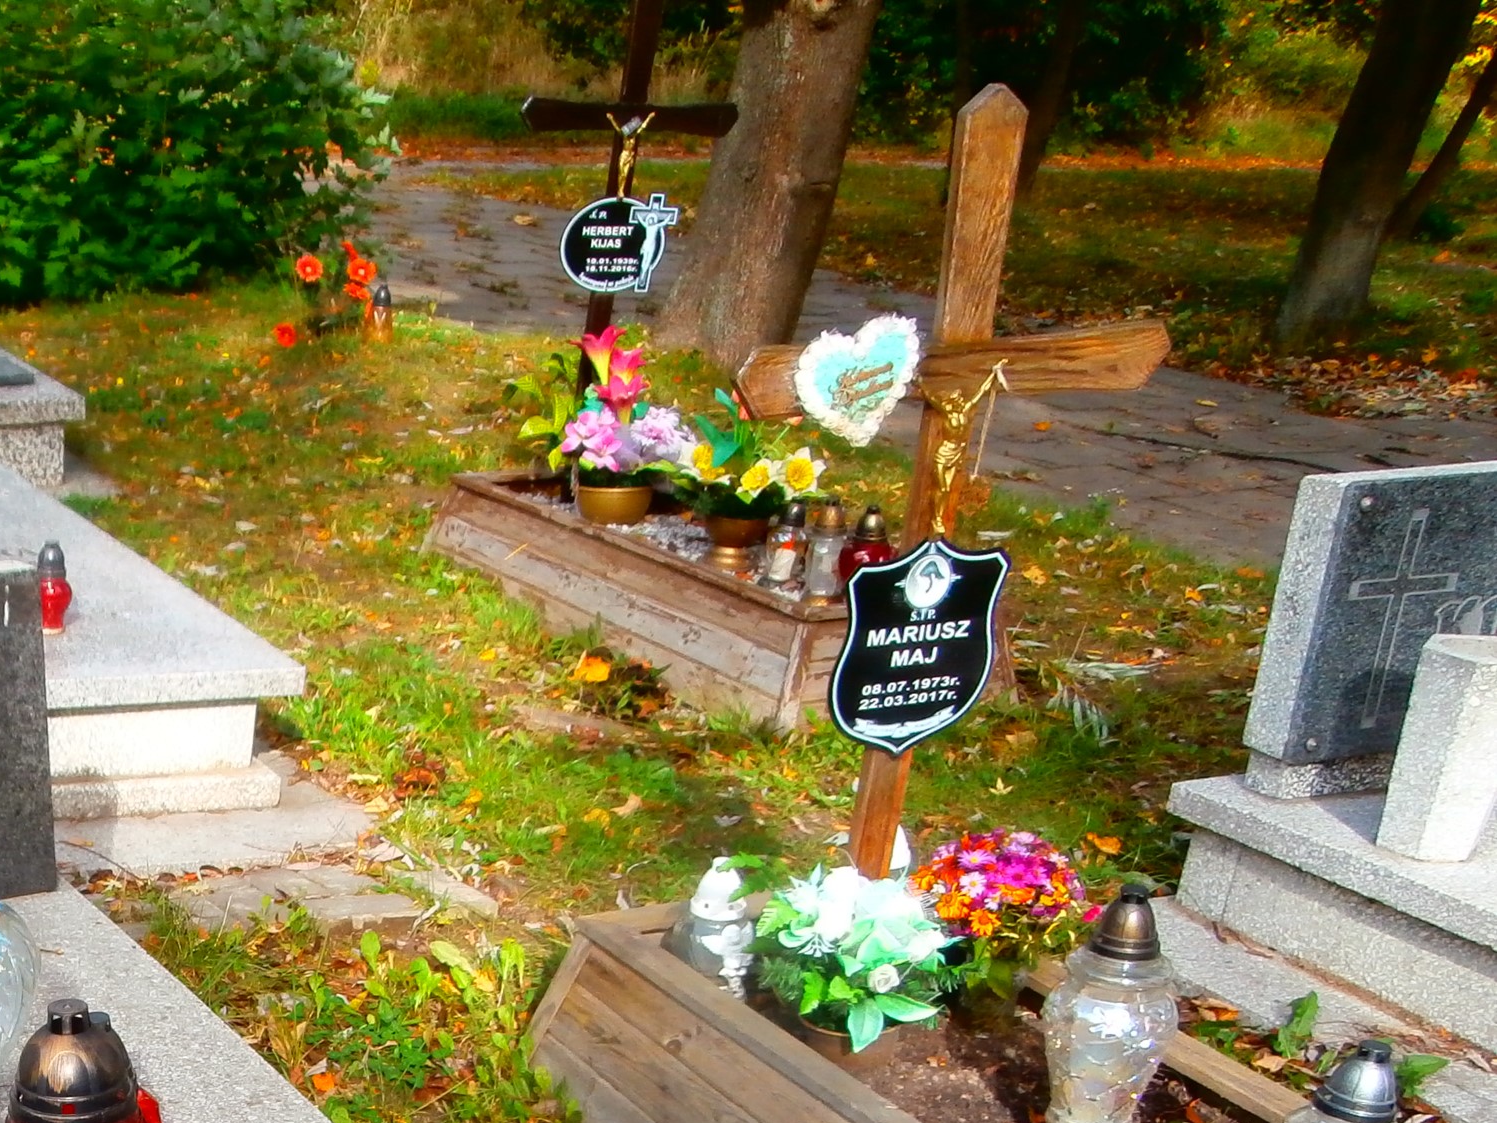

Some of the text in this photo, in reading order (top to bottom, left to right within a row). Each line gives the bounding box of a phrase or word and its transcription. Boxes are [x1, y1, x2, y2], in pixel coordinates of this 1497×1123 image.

[582, 226, 634, 236] HERBERT
[590, 238, 622, 249] KIJAS
[866, 620, 971, 647] MARIUSZ
[890, 647, 938, 668] MAJ
[861, 676, 961, 697] 08.07.1973r.
[858, 690, 958, 711] 22.03.2017r.
